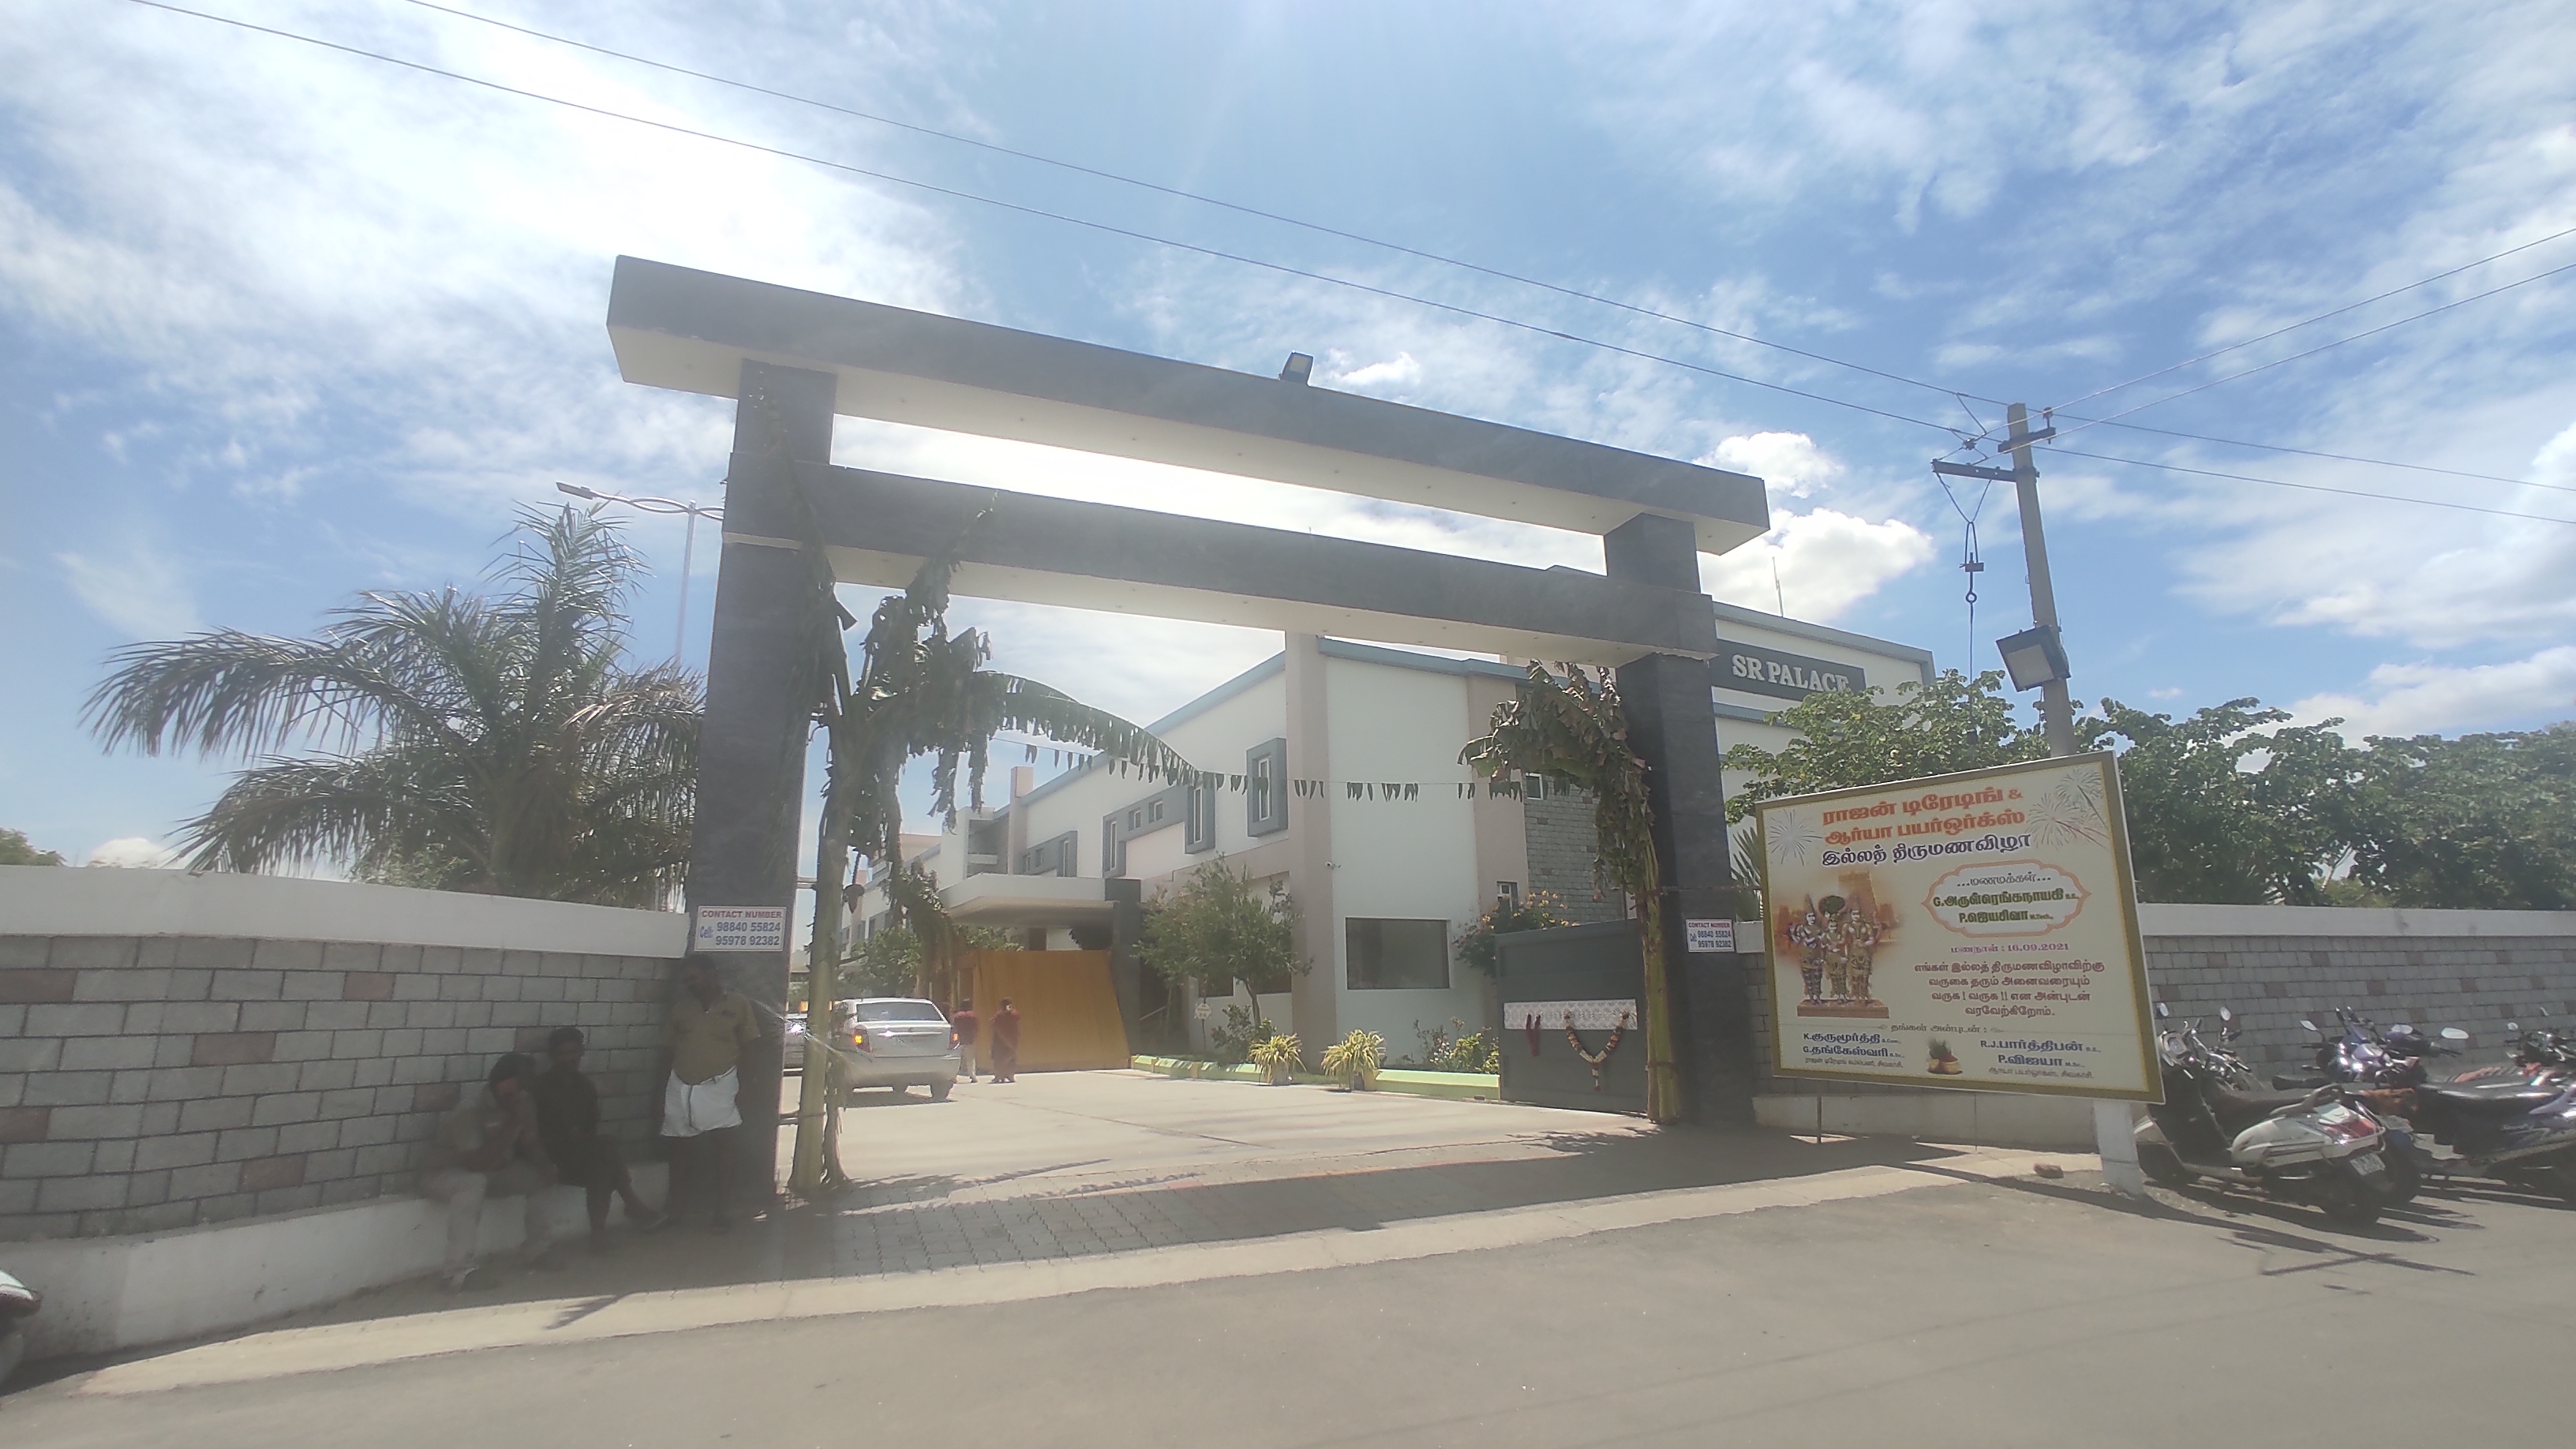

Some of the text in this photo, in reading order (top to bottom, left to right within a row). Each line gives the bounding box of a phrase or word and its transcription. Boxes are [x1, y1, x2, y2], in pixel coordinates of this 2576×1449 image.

[1732, 654, 1851, 693] SR PALACE
[1823, 786, 2023, 826] ராஜன் டிரேடிங் &
[1825, 808, 2026, 845] ஆர்யா பயர்ஒர்க்ஸ்
[1822, 833, 2032, 866] இல்லத் திருமணவிழா
[717, 922, 781, 932] 98840 55824
[715, 935, 780, 945] 95978 92382
[2008, 943, 2069, 952] 16.09.2021
[1914, 959, 2105, 974] எங்கள் இல்லத் திருமணவிழாவிற்கு
[1929, 974, 2090, 988] வருகை தரும் அனைவரையும்
[1931, 992, 1960, 1002] வருக
[1968, 992, 1998, 1002] வருக
[2010, 992, 2031, 1001] என
[2034, 990, 2091, 1003] அன்புடன்
[1964, 1005, 2055, 1018] வரவேற்கிறோம்.
[1890, 1024, 1926, 1032] தங்கள்
[1930, 1024, 1981, 1034] அன்புடன்
[1980, 1039, 2084, 1052] R.J.பார்த்திபன்
[1998, 1054, 2063, 1066] P.விஜயா
